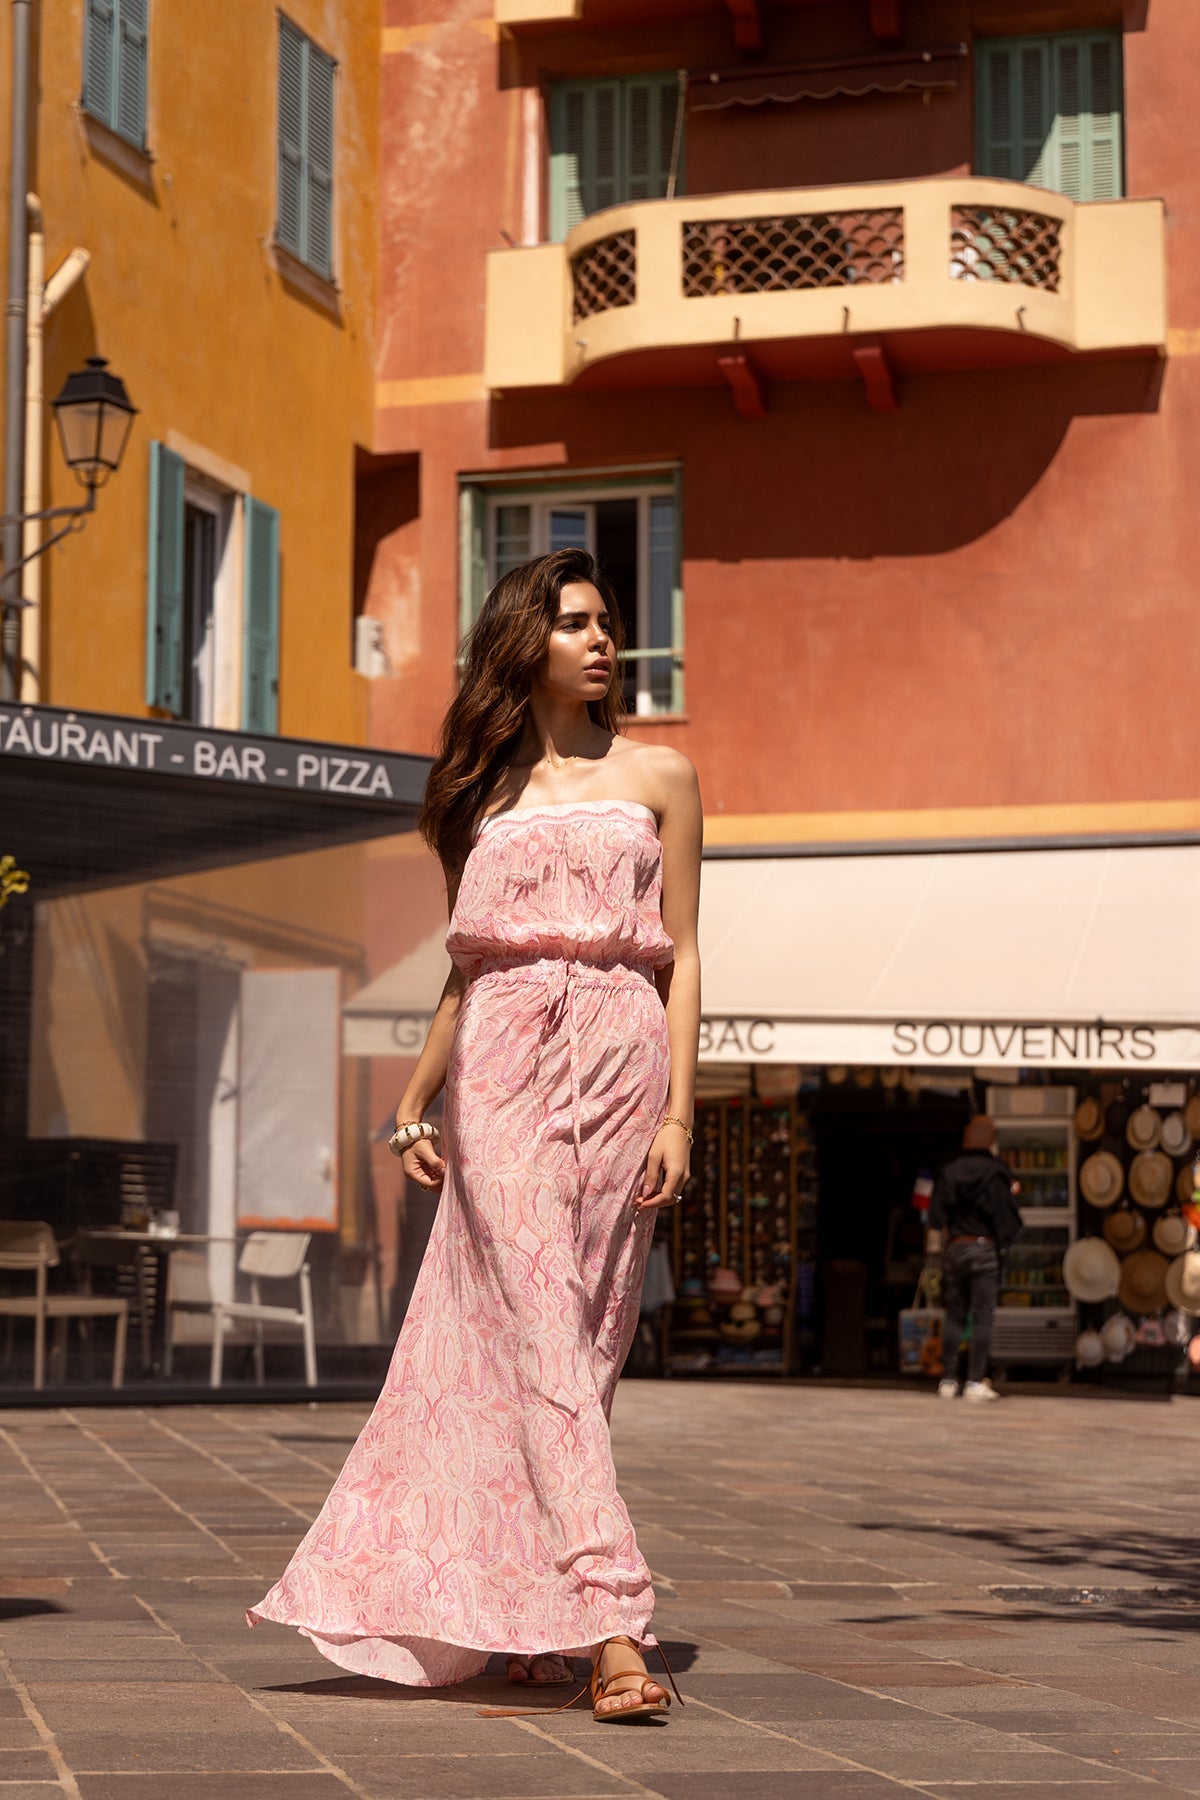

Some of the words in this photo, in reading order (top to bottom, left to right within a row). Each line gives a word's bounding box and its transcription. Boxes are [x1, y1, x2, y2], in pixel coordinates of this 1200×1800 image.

[194, 741, 266, 783] BAR
[297, 754, 393, 798] PIZZA
[892, 1023, 1156, 1060] SOUVENIRS
